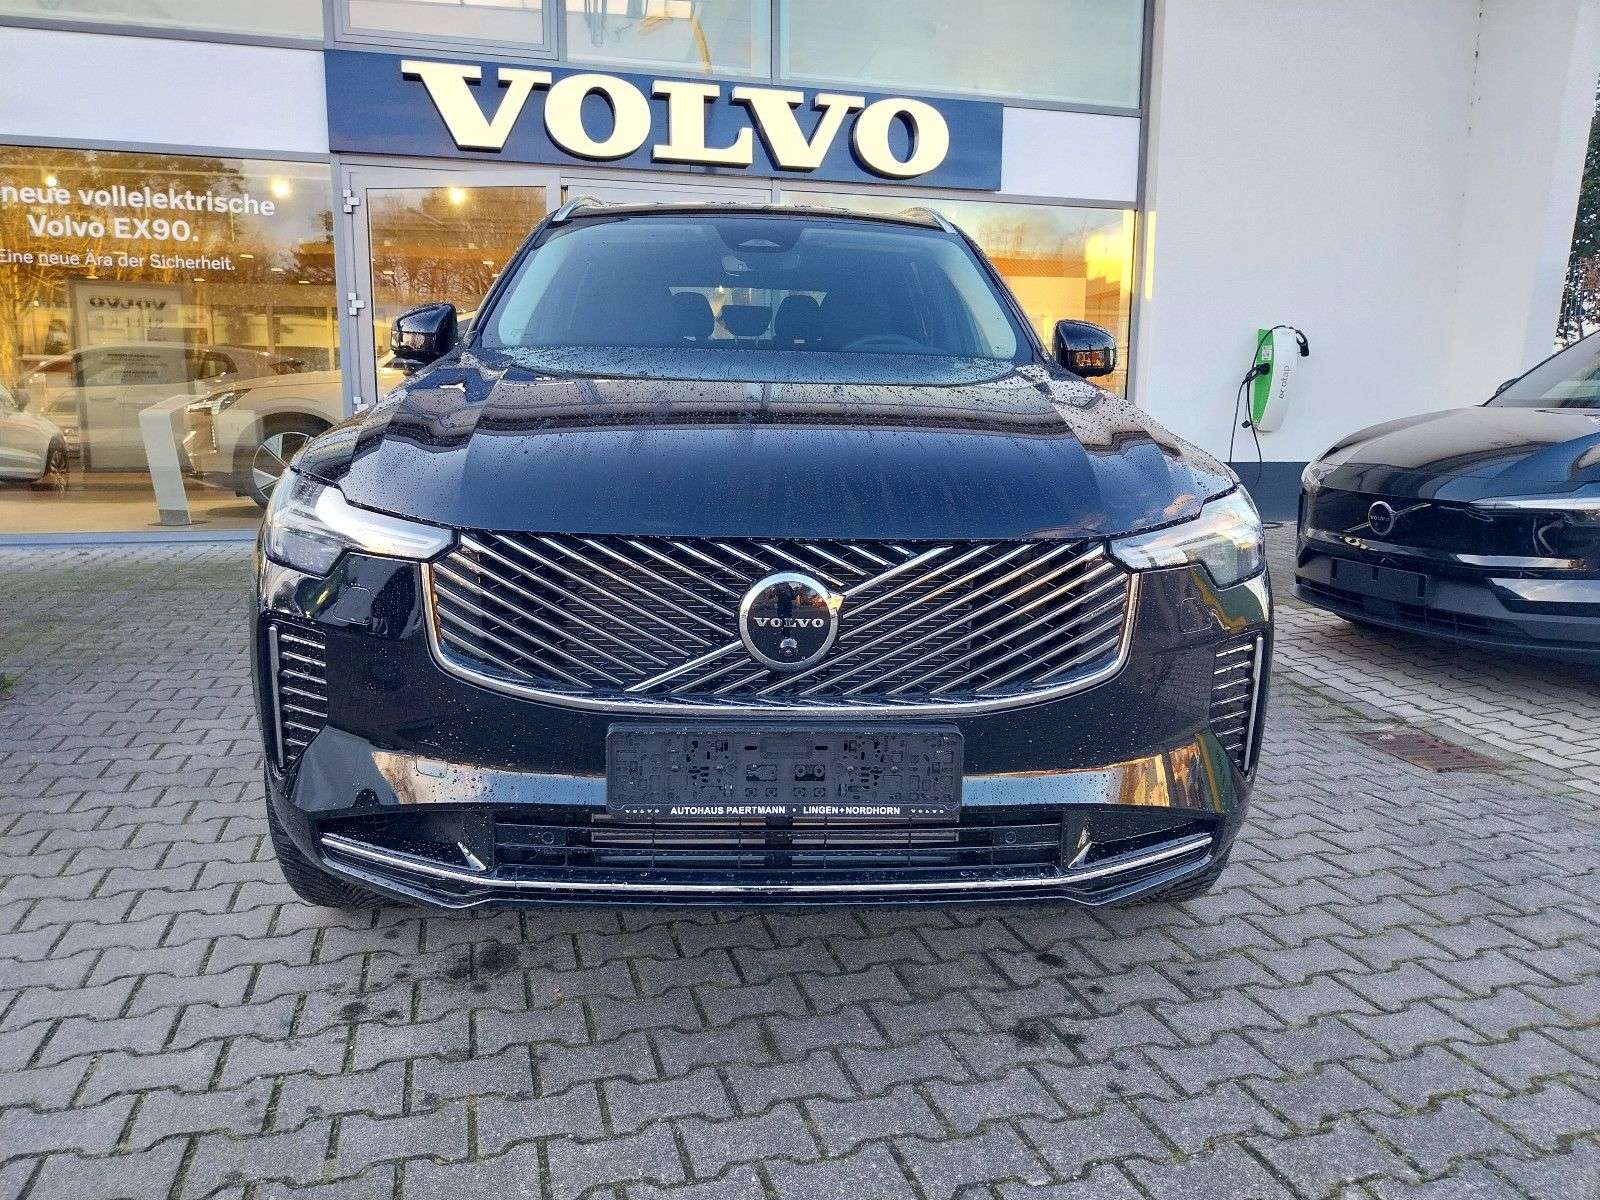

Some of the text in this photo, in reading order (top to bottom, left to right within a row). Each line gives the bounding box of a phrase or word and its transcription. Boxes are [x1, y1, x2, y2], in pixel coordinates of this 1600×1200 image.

[401, 59, 950, 179] VOLVO
[0, 185, 276, 216] neue vollelektrische
[27, 214, 199, 242] Volvo EX90.
[38, 251, 80, 265] neue
[84, 248, 113, 267] Ära
[118, 252, 144, 267] der
[149, 253, 236, 271] Sicherheit.
[754, 617, 824, 628] VOLVO
[670, 806, 725, 815] AUTOHAUS
[726, 805, 786, 815] PAERTMANN
[803, 805, 901, 815] LINGEN+NORDHORN
